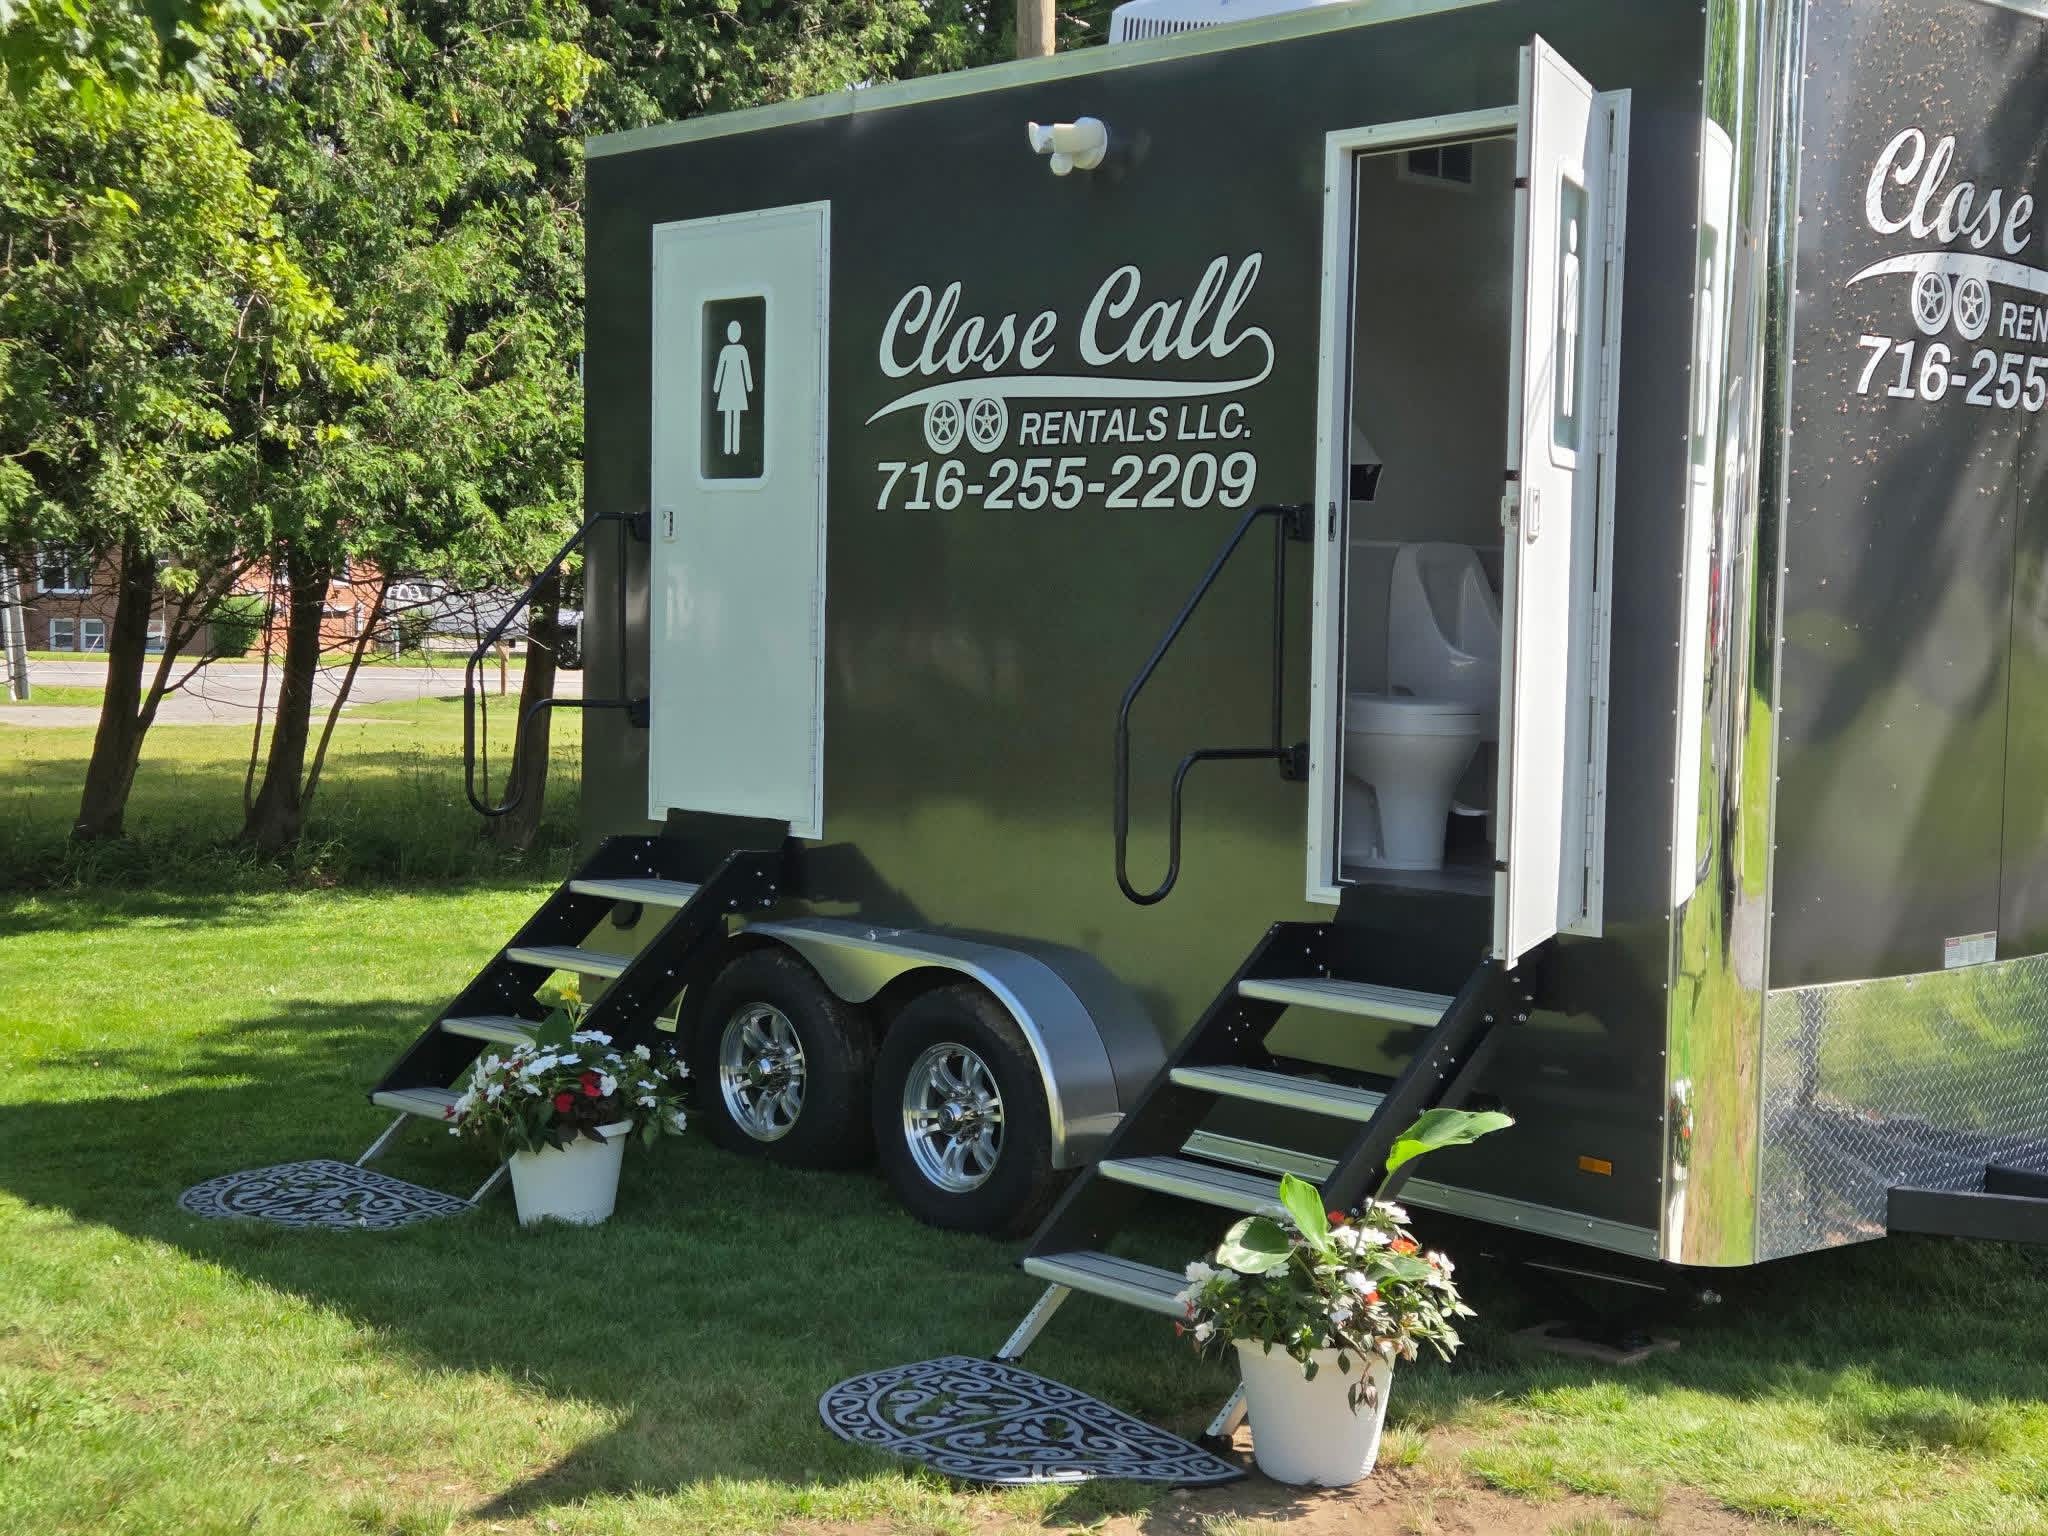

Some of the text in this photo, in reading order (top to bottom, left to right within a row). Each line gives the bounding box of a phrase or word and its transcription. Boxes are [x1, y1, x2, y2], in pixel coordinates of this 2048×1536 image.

[1866, 126, 2033, 255] Close
[879, 252, 1275, 378] Close Call
[1019, 402, 1252, 446] RENTALS LLC.
[876, 451, 1258, 511] 716-255-2209
